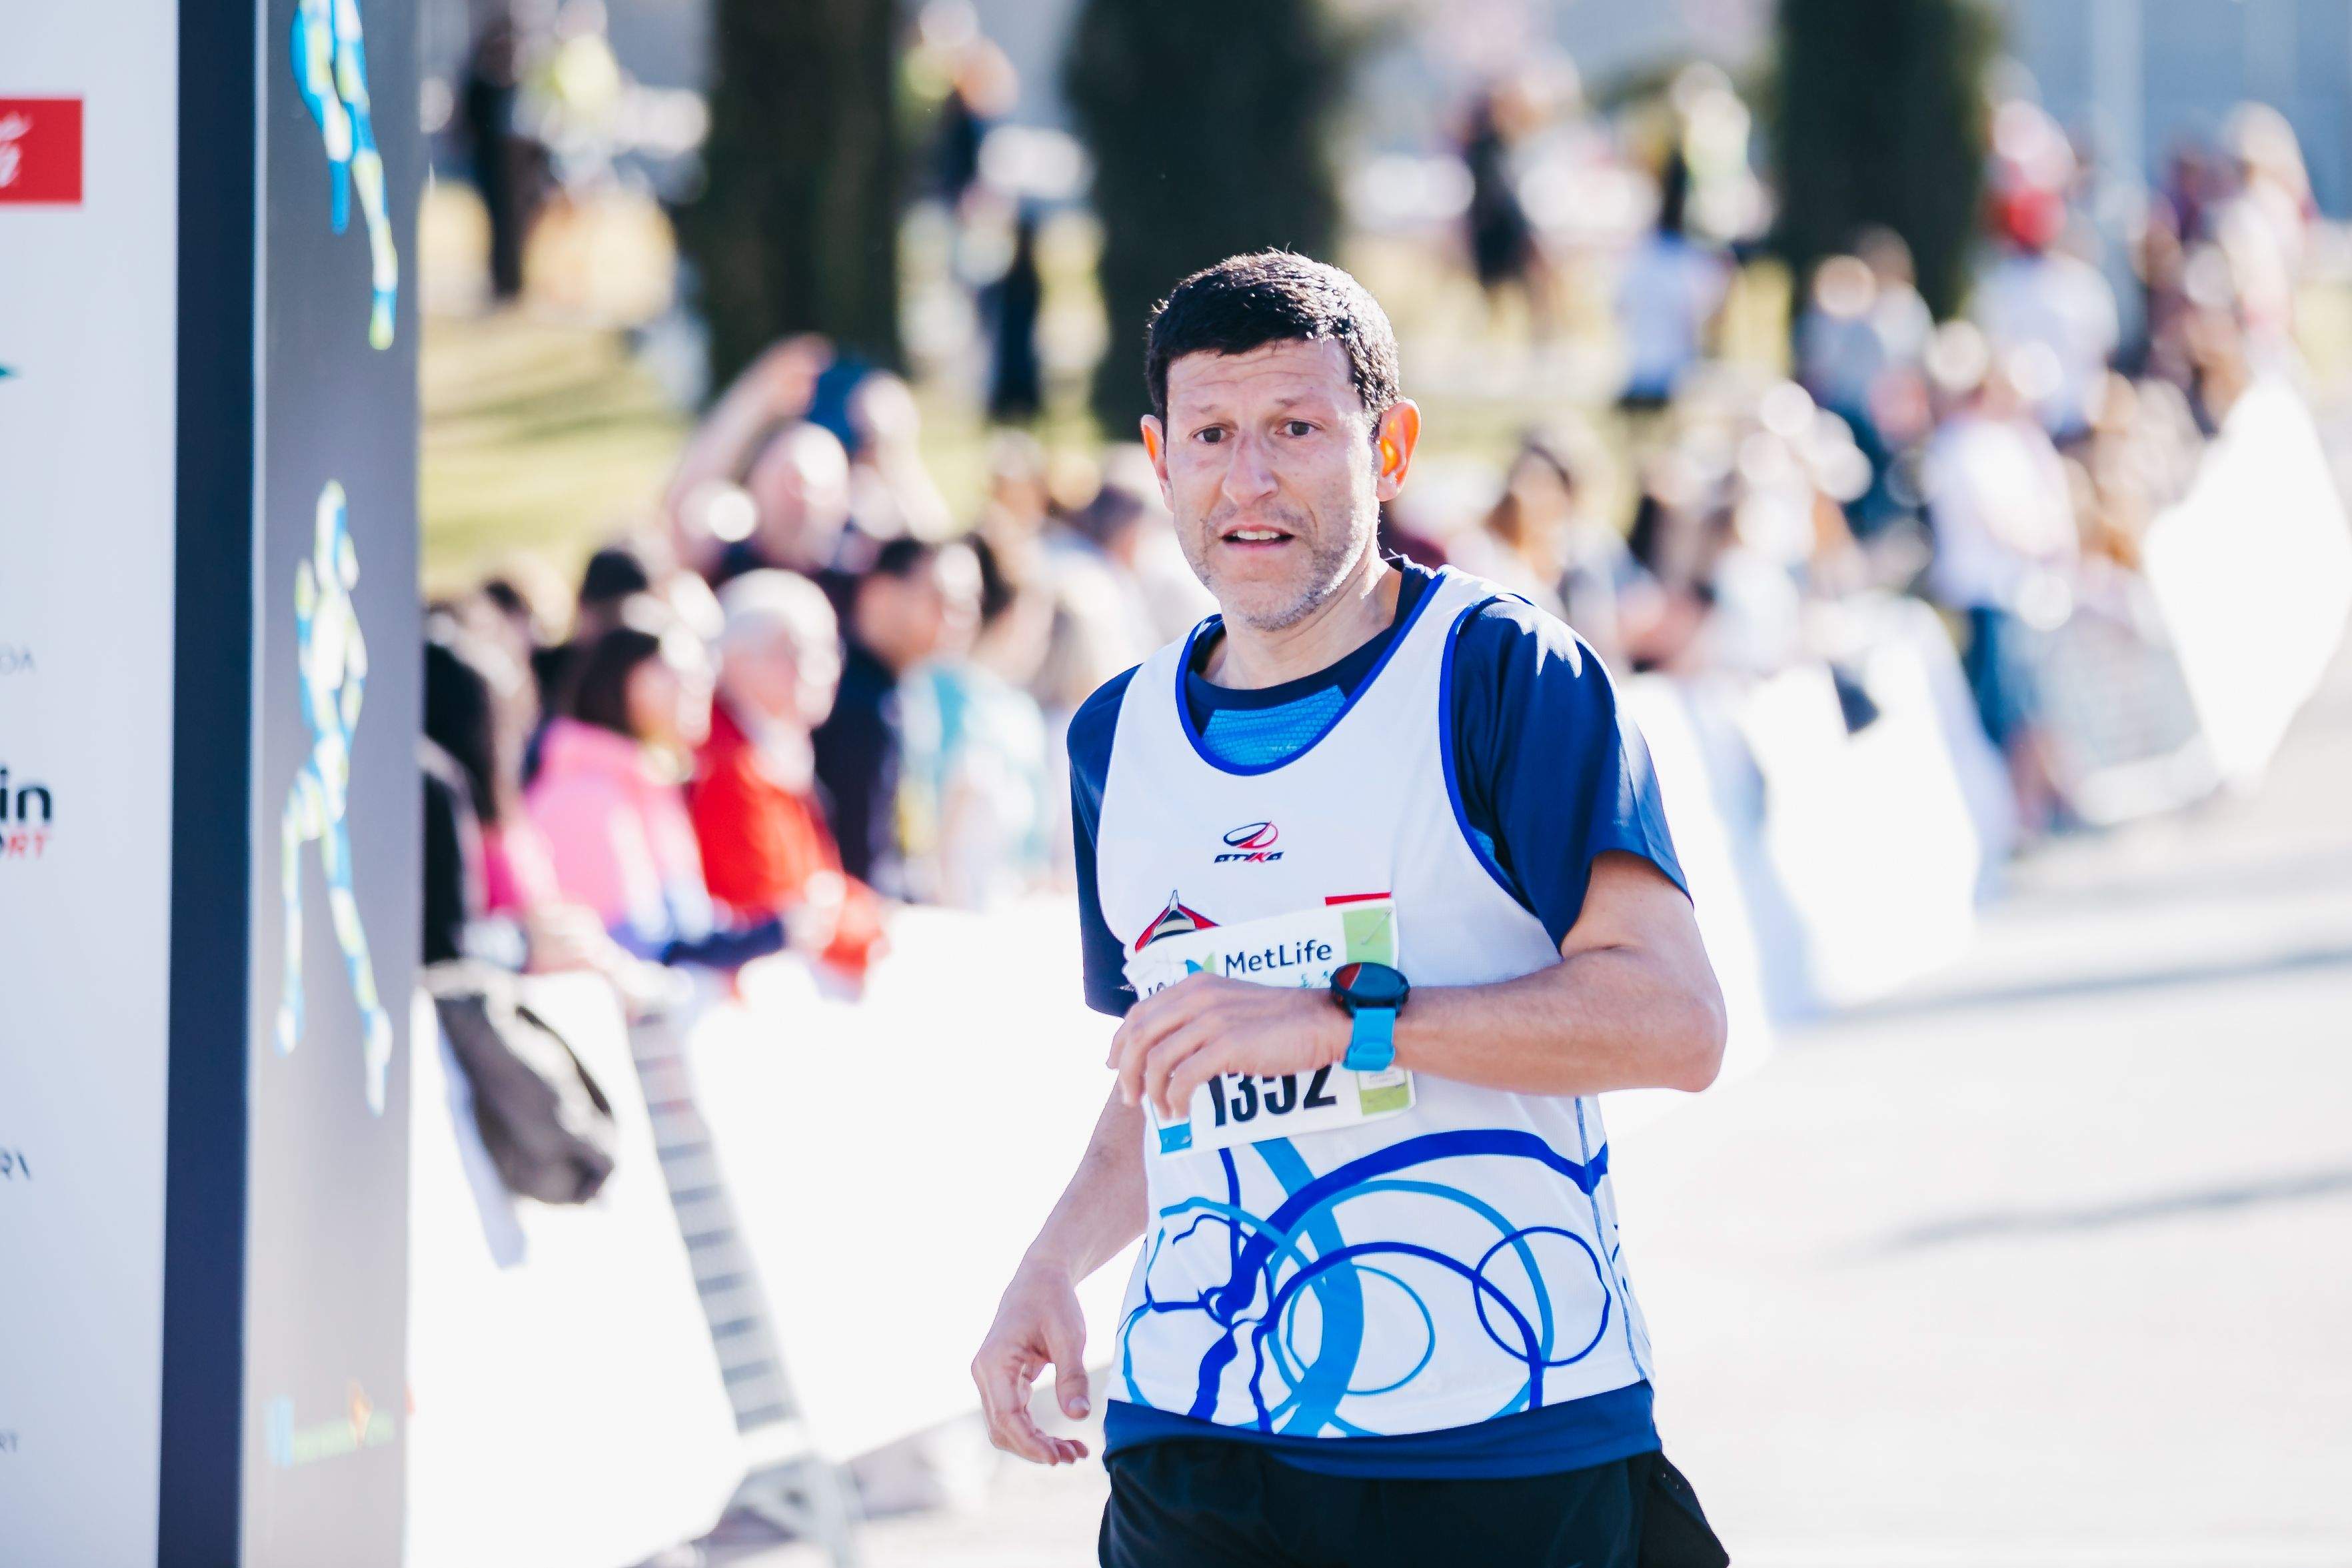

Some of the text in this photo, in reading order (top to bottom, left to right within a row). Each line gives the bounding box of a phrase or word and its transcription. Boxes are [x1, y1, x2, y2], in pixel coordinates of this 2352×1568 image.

[0, 831, 48, 859] RT
[1226, 940, 1332, 978] MetLife
[1208, 1064, 1337, 1128] 1352
